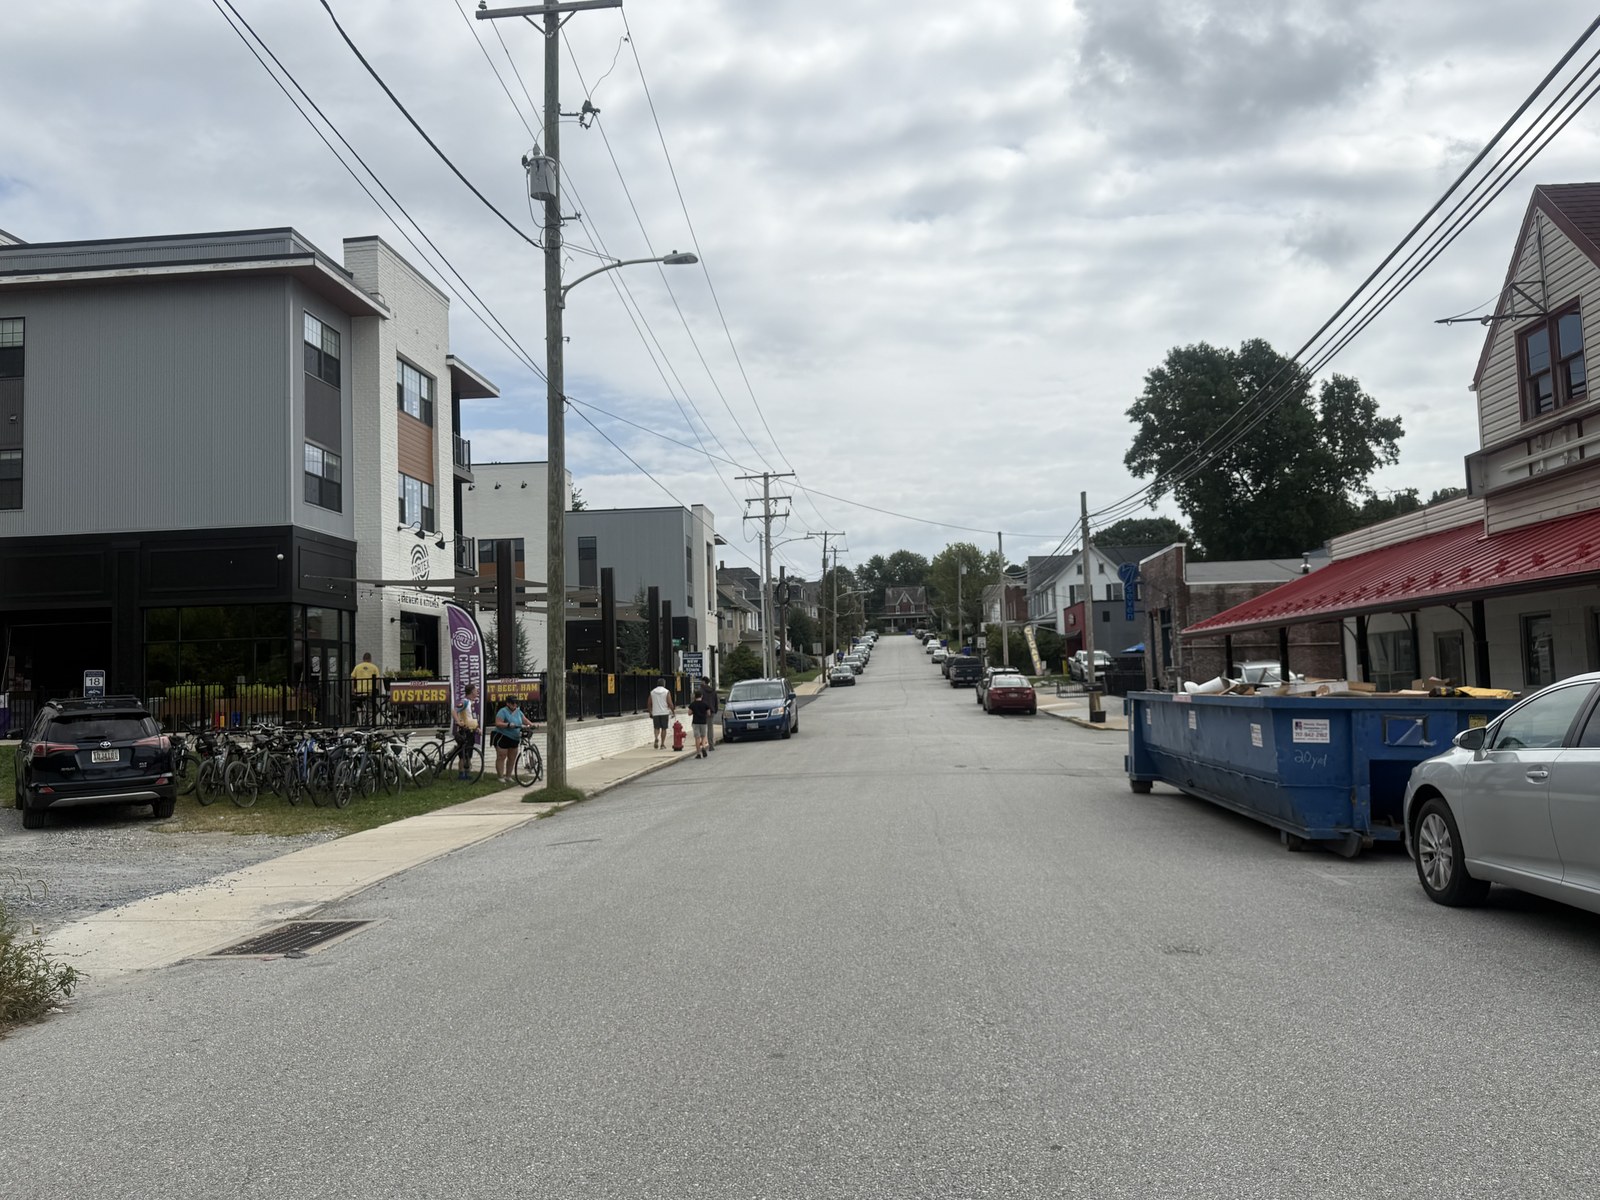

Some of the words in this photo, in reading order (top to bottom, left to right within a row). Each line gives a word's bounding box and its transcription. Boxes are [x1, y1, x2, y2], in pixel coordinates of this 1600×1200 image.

[452, 633, 476, 646] VORTEX
[89, 678, 101, 686] 18
[521, 683, 538, 691] HAM
[393, 690, 446, 701] OYSTERS
